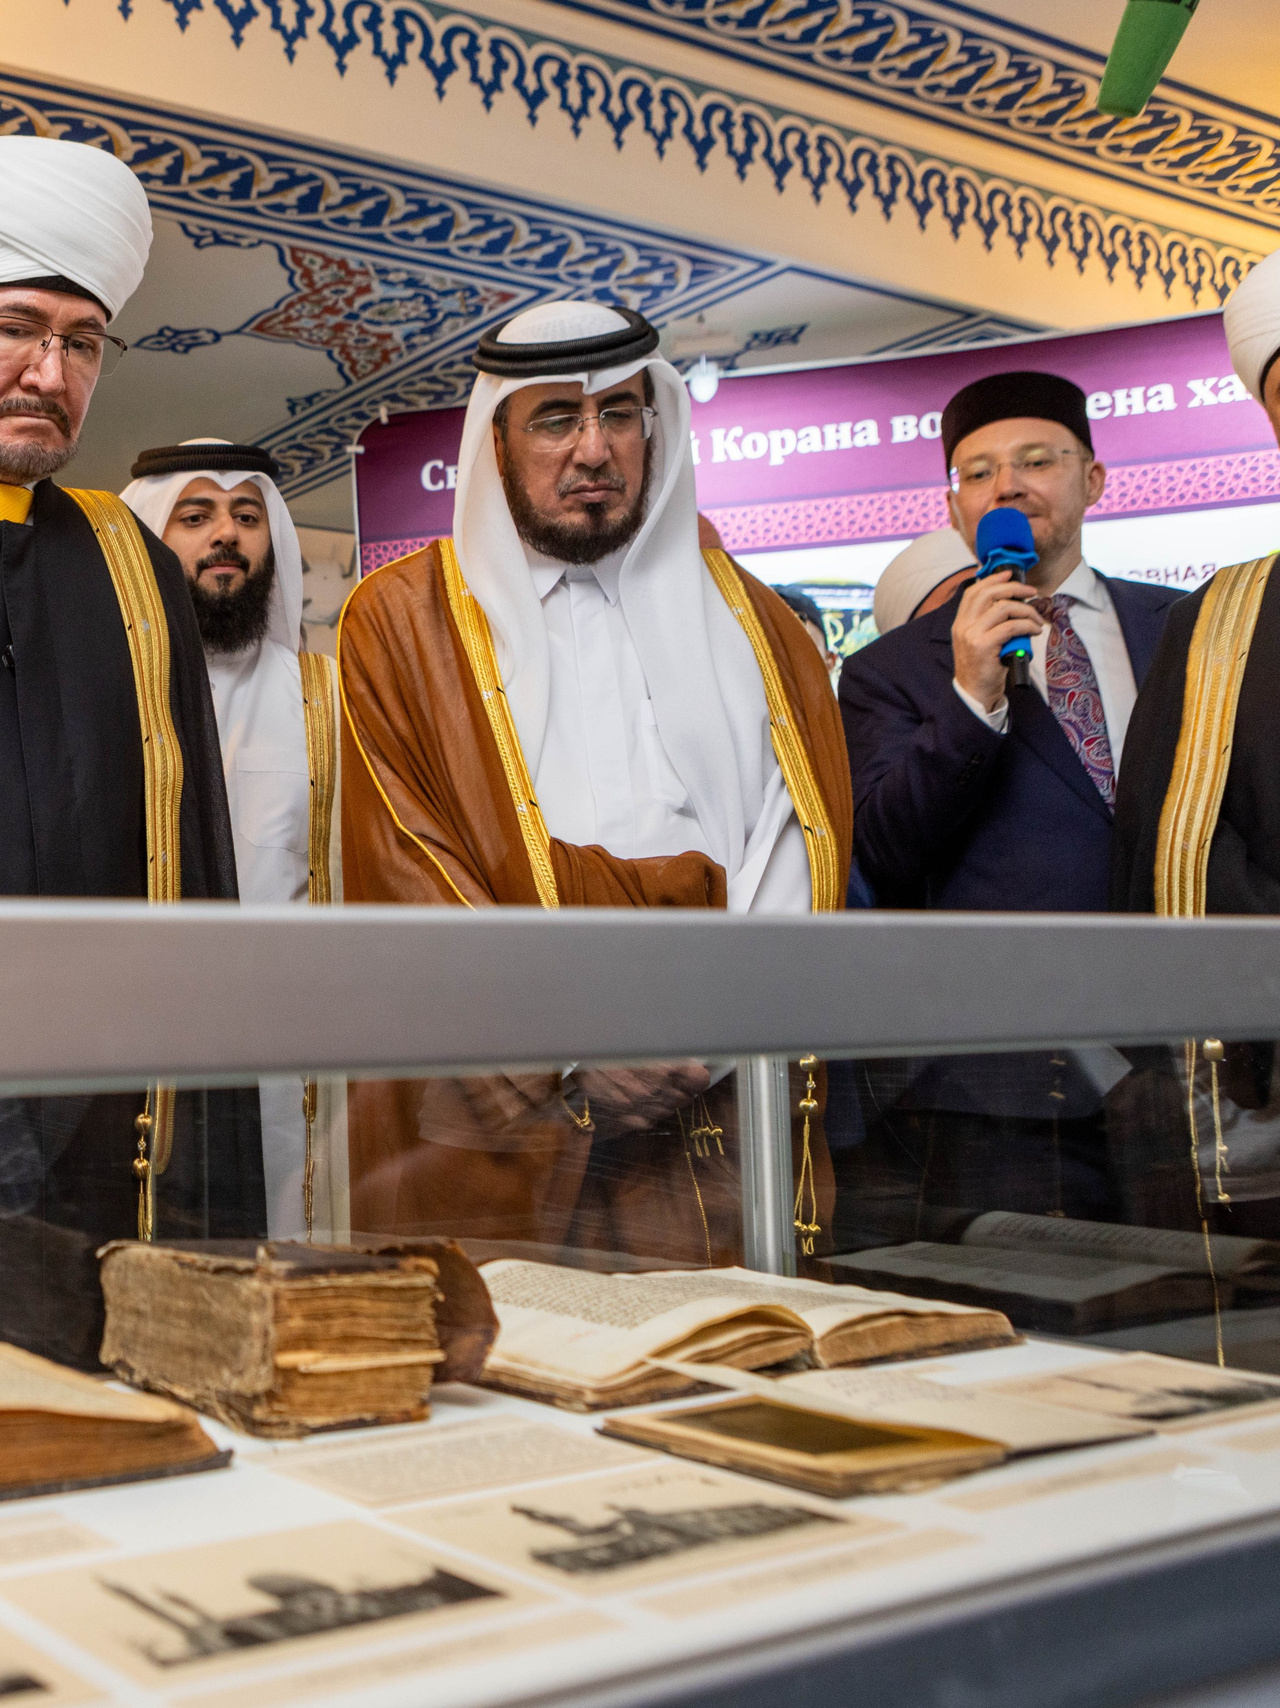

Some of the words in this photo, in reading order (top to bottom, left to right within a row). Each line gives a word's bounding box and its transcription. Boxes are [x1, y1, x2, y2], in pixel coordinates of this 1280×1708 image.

[709, 418, 881, 466] Корана
[889, 411, 943, 444] во
[1085, 382, 1178, 420] ена
[1186, 373, 1253, 409] ха
